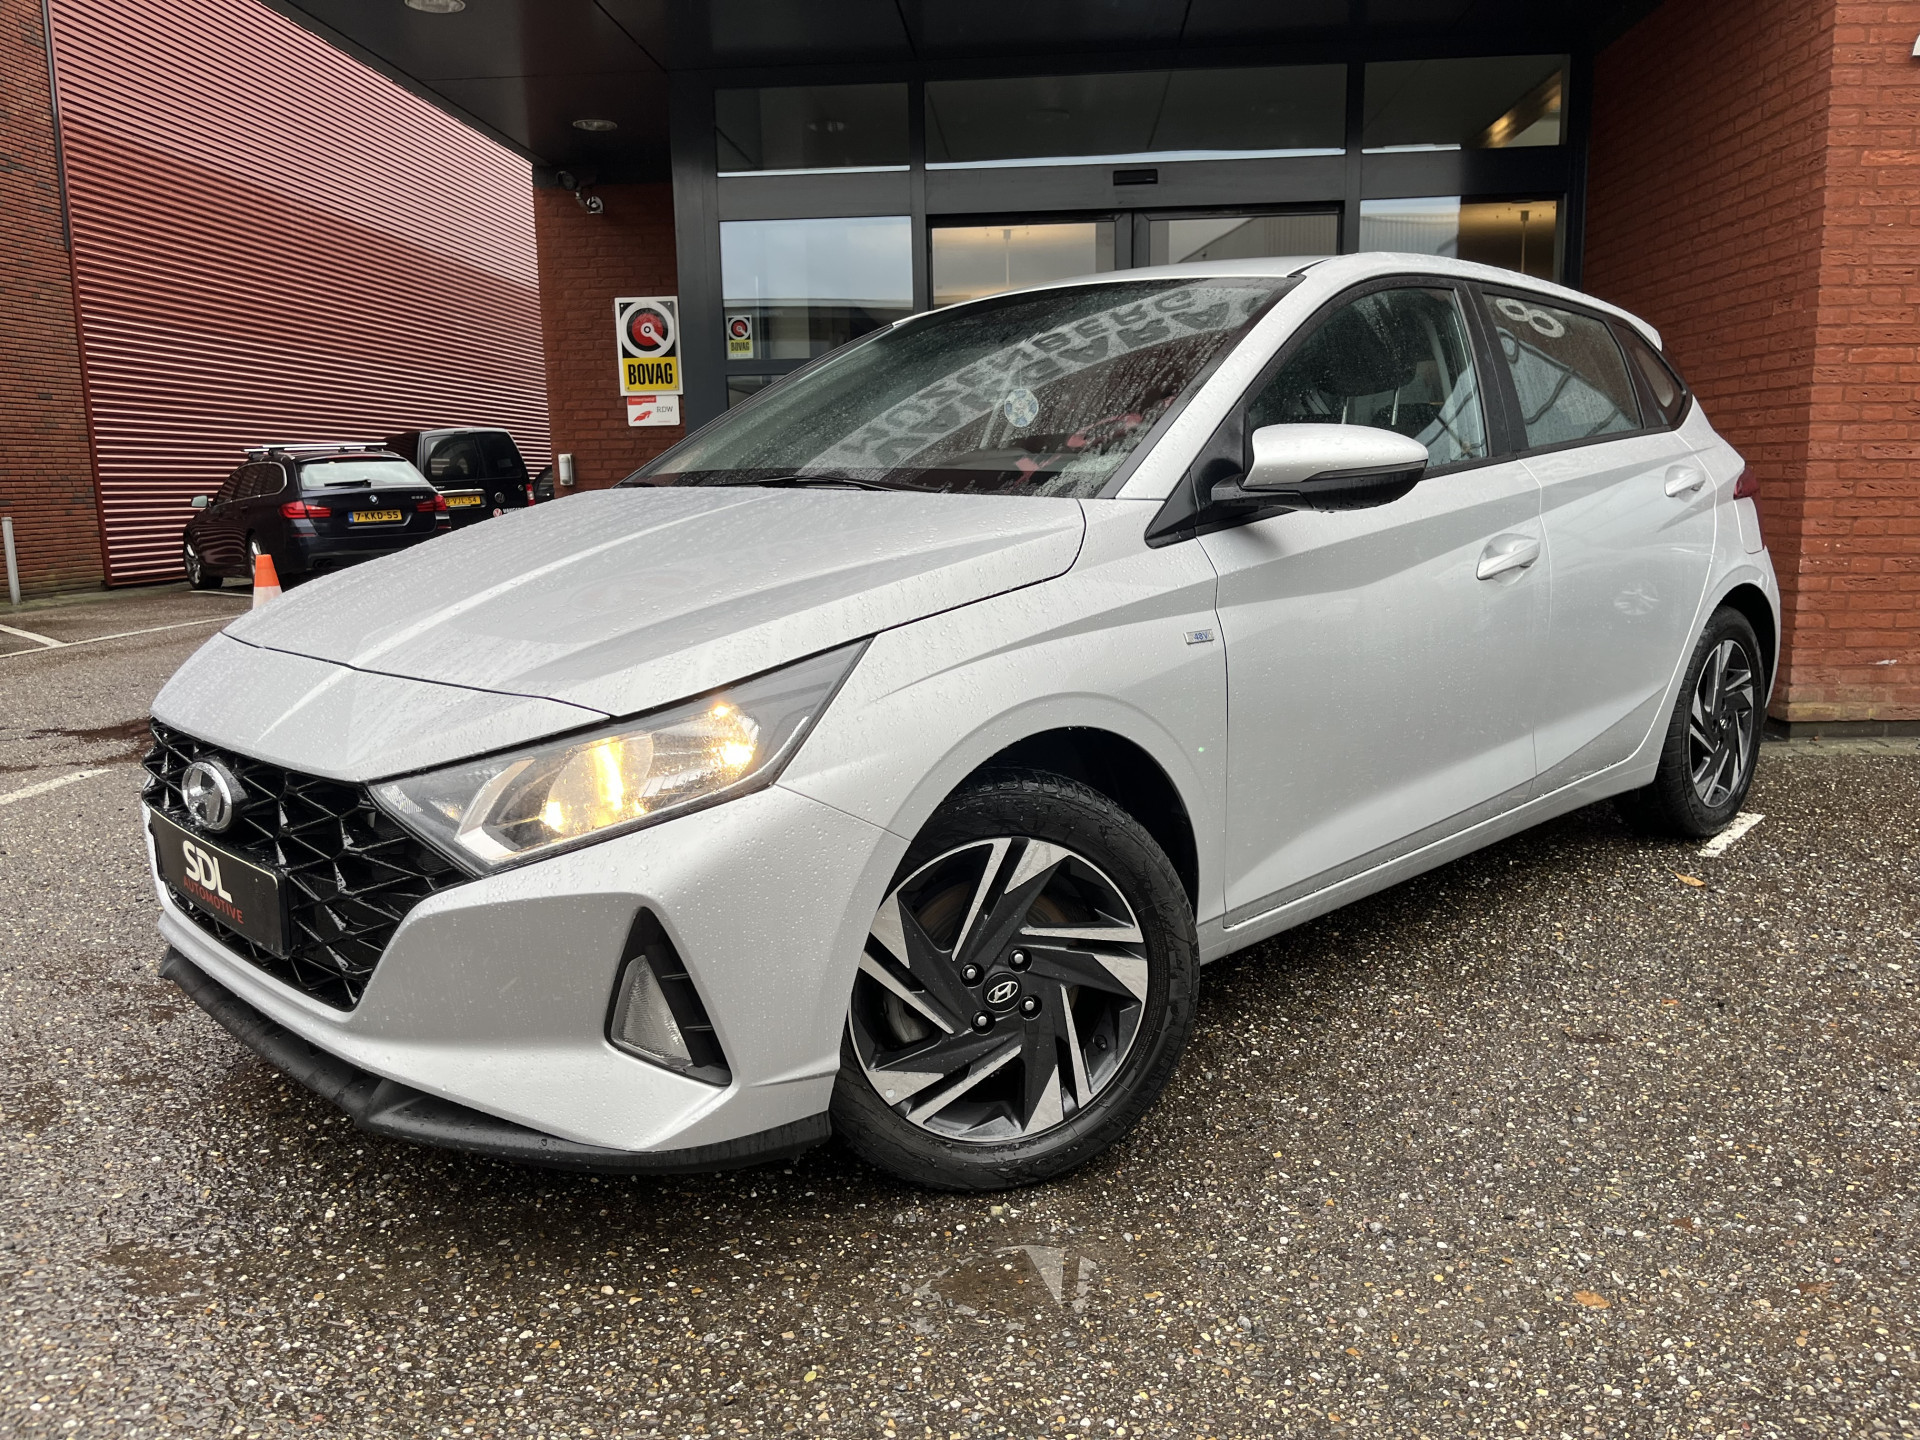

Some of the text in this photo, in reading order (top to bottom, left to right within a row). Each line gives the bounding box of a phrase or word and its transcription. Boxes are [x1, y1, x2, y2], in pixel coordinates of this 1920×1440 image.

[730, 342, 750, 352] BOVAG
[628, 362, 674, 386] BOVAG
[355, 511, 399, 521] 7-KKD-55
[1194, 632, 1208, 640] 48V
[182, 840, 233, 904] SDL
[183, 875, 244, 925] AUTOMOTIVE
